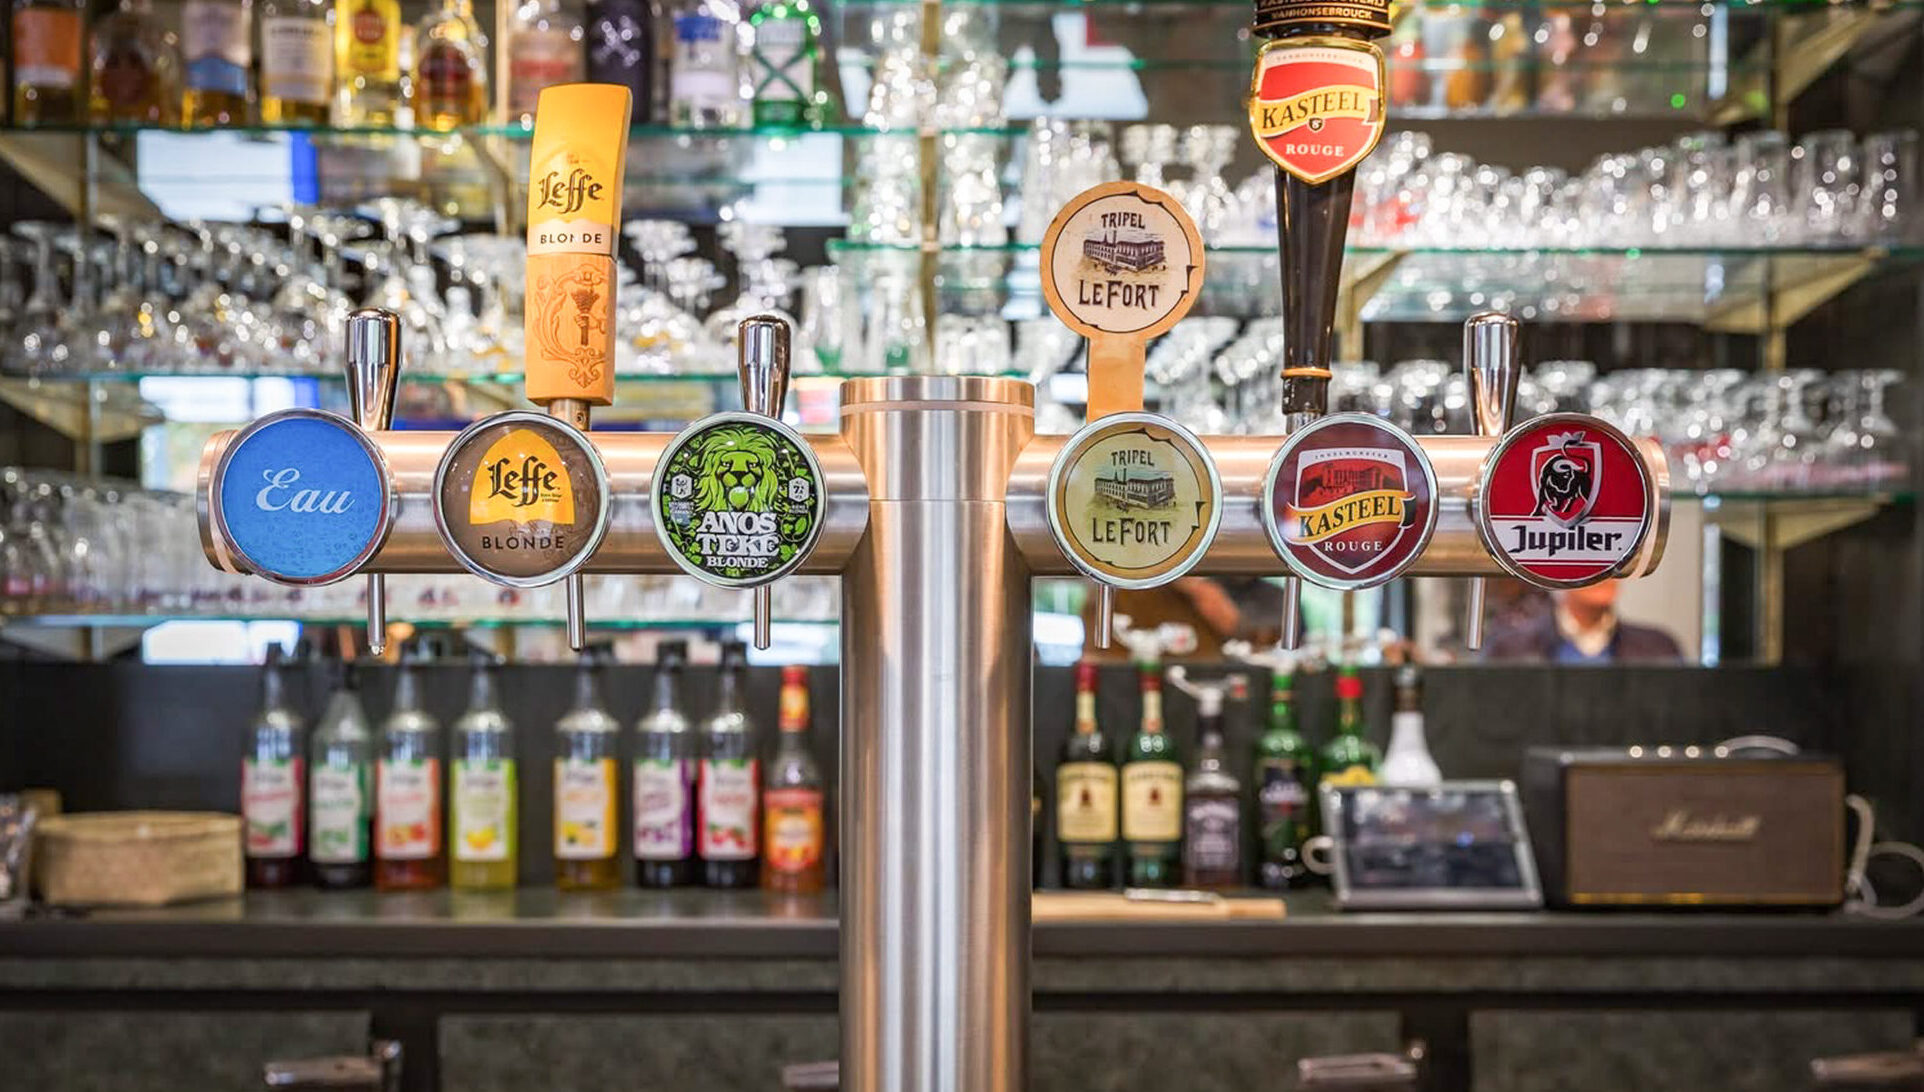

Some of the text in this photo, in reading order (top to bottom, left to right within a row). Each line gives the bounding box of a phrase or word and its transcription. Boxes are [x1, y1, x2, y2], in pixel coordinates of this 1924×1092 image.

[1262, 91, 1365, 129] KASTEEL
[1285, 143, 1345, 157] ROUGE
[537, 168, 603, 214] Leffe
[1101, 212, 1145, 229] TRIPEL
[1111, 449, 1155, 467] TRIPEL
[256, 467, 356, 514] Eau
[487, 455, 559, 508] Leffe
[696, 511, 778, 535] ANOS
[1300, 496, 1400, 538] KASTEEL
[482, 536, 565, 550] BLONDE
[1324, 541, 1383, 552] ROUGE
[706, 555, 769, 569] BLONDE
